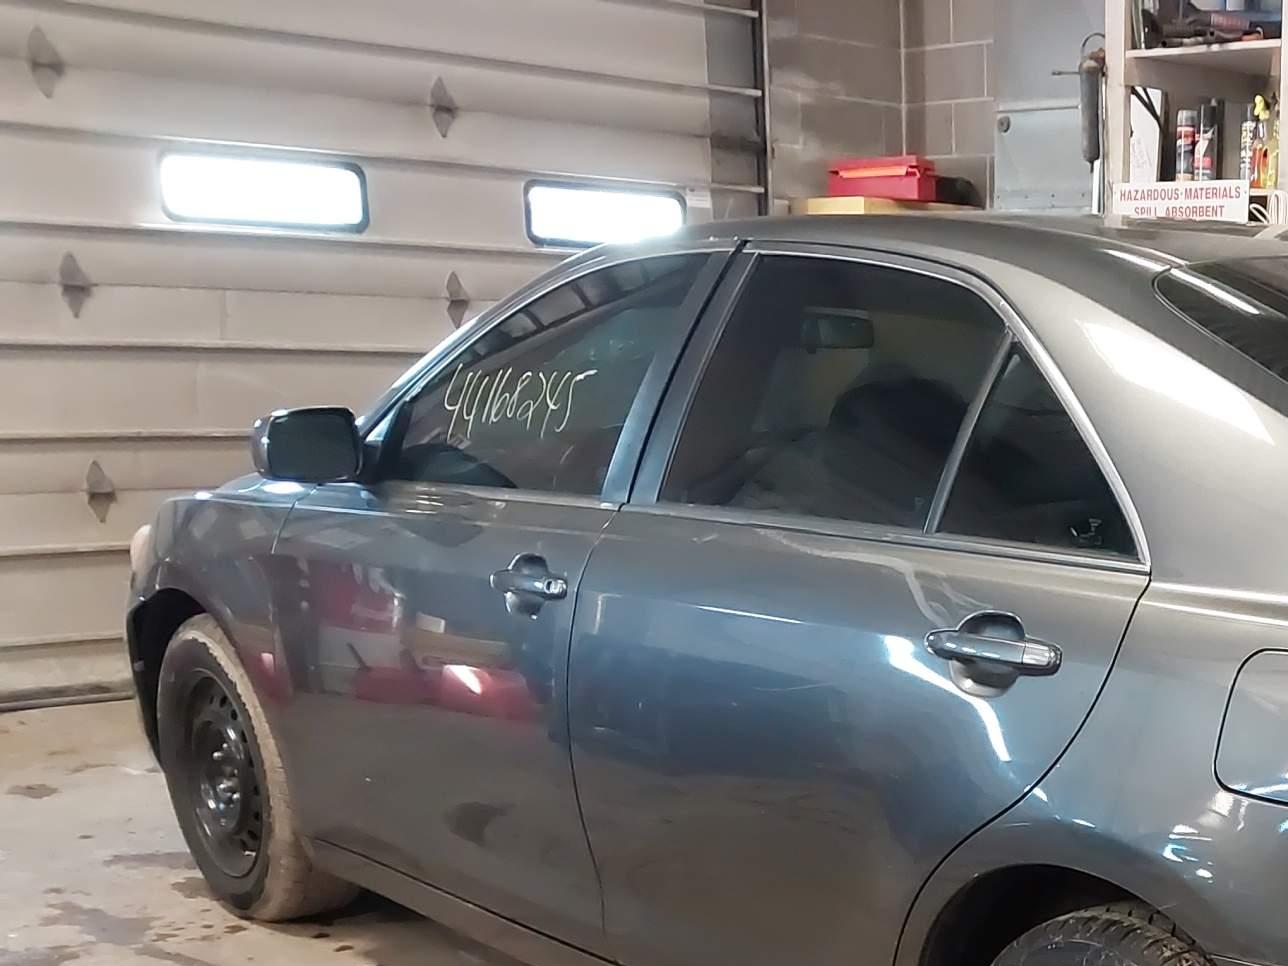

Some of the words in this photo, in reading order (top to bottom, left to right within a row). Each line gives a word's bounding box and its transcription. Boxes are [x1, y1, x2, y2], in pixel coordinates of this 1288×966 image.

[1119, 187, 1180, 201] HAZARDOUS
[1183, 185, 1241, 201] MATERIALS
[1133, 206, 1158, 217] SPILL
[1165, 205, 1225, 218] ABSORBENT
